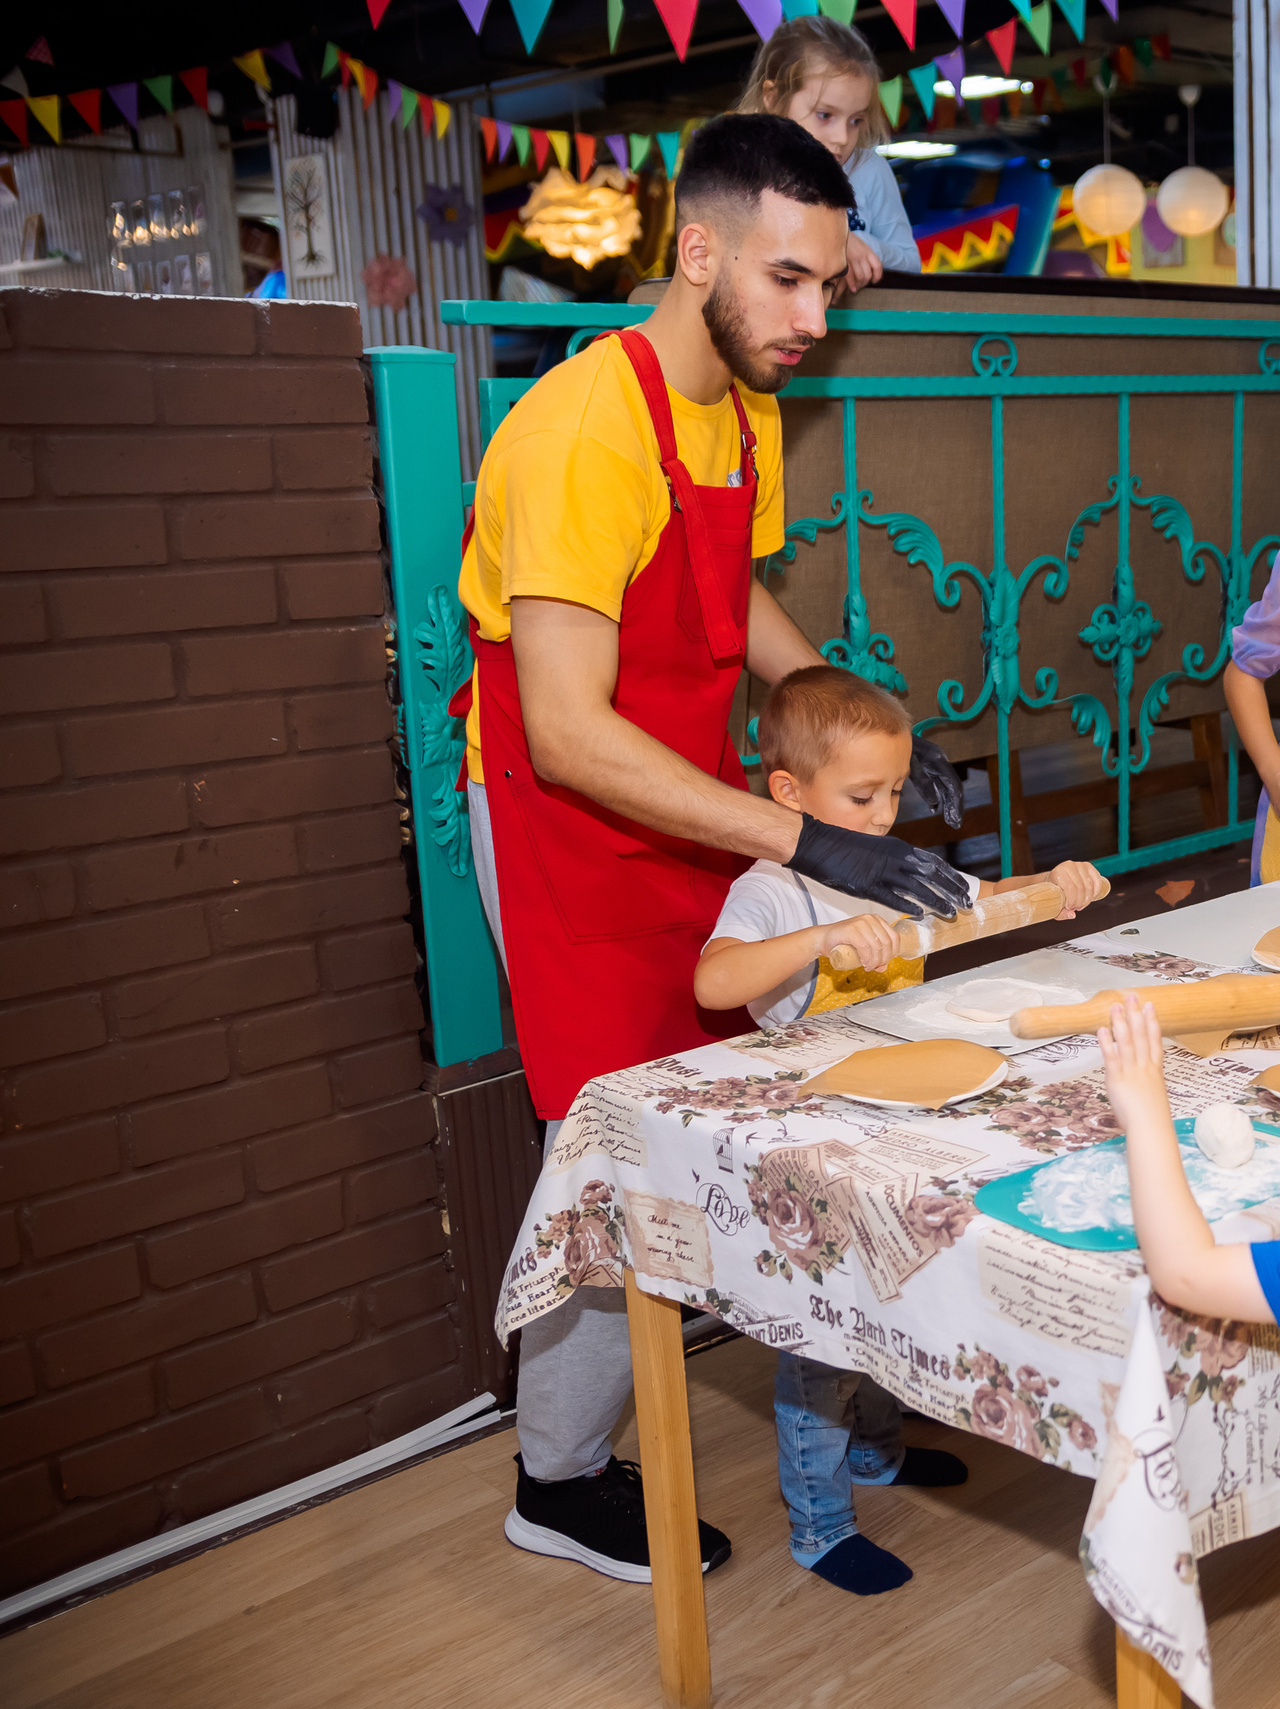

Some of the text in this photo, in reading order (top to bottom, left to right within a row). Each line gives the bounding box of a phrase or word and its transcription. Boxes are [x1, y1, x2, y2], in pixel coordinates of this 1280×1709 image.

[696, 1183, 751, 1237] Love
[768, 1322, 804, 1344] DENIS
[809, 1293, 844, 1330] The
[890, 1328, 951, 1381] Times
